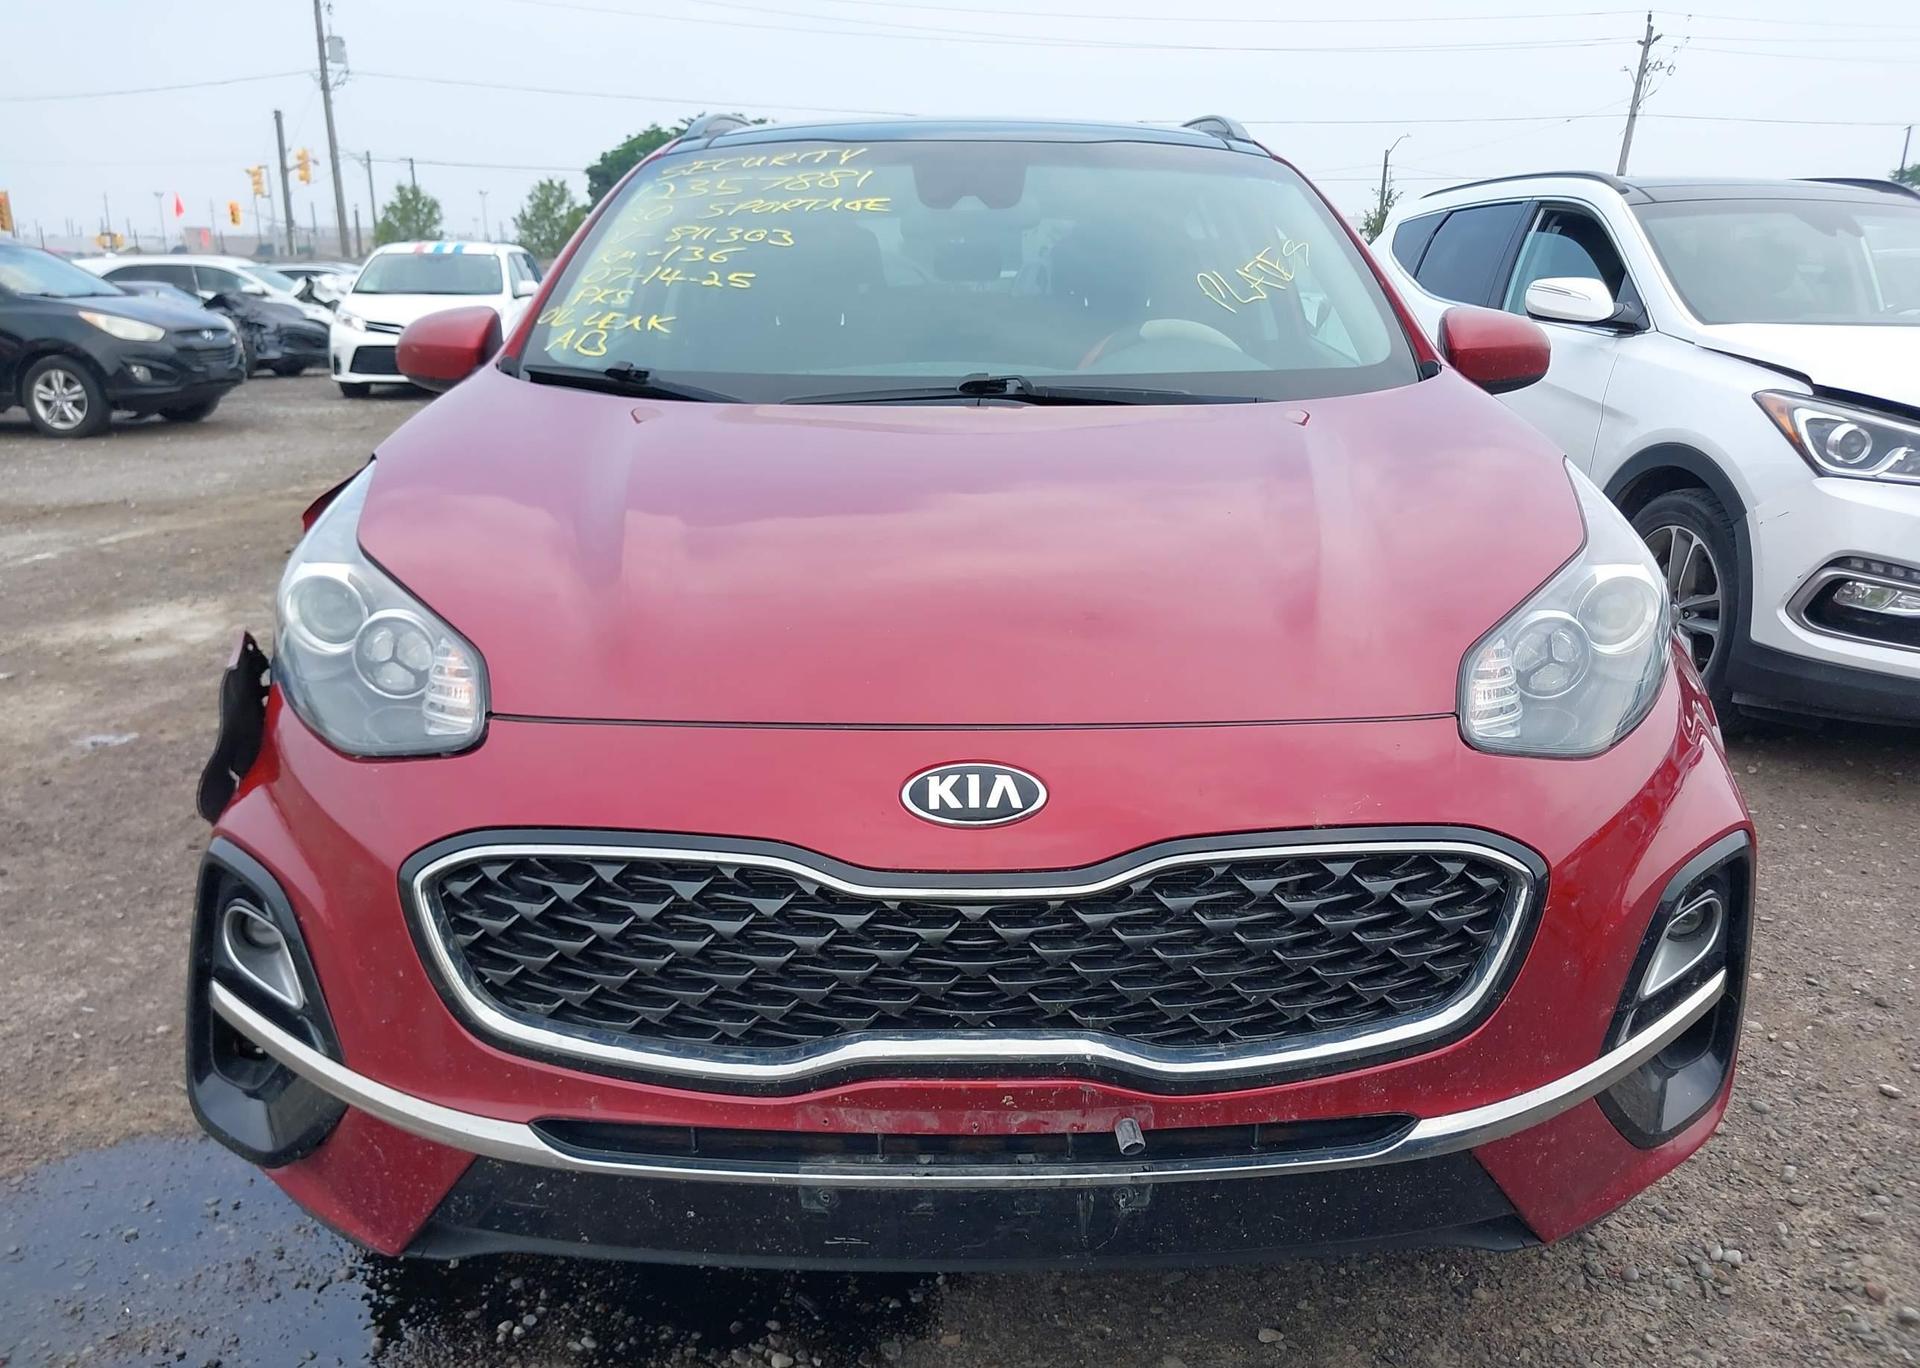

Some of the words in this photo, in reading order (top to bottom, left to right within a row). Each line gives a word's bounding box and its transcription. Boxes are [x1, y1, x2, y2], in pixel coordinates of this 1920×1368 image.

[656, 148, 868, 182] SECURITY
[697, 198, 892, 219] SPORTAGE
[1197, 239, 1310, 314] PLATES
[583, 311, 677, 333] LEAK
[927, 773, 1023, 809] KIA
